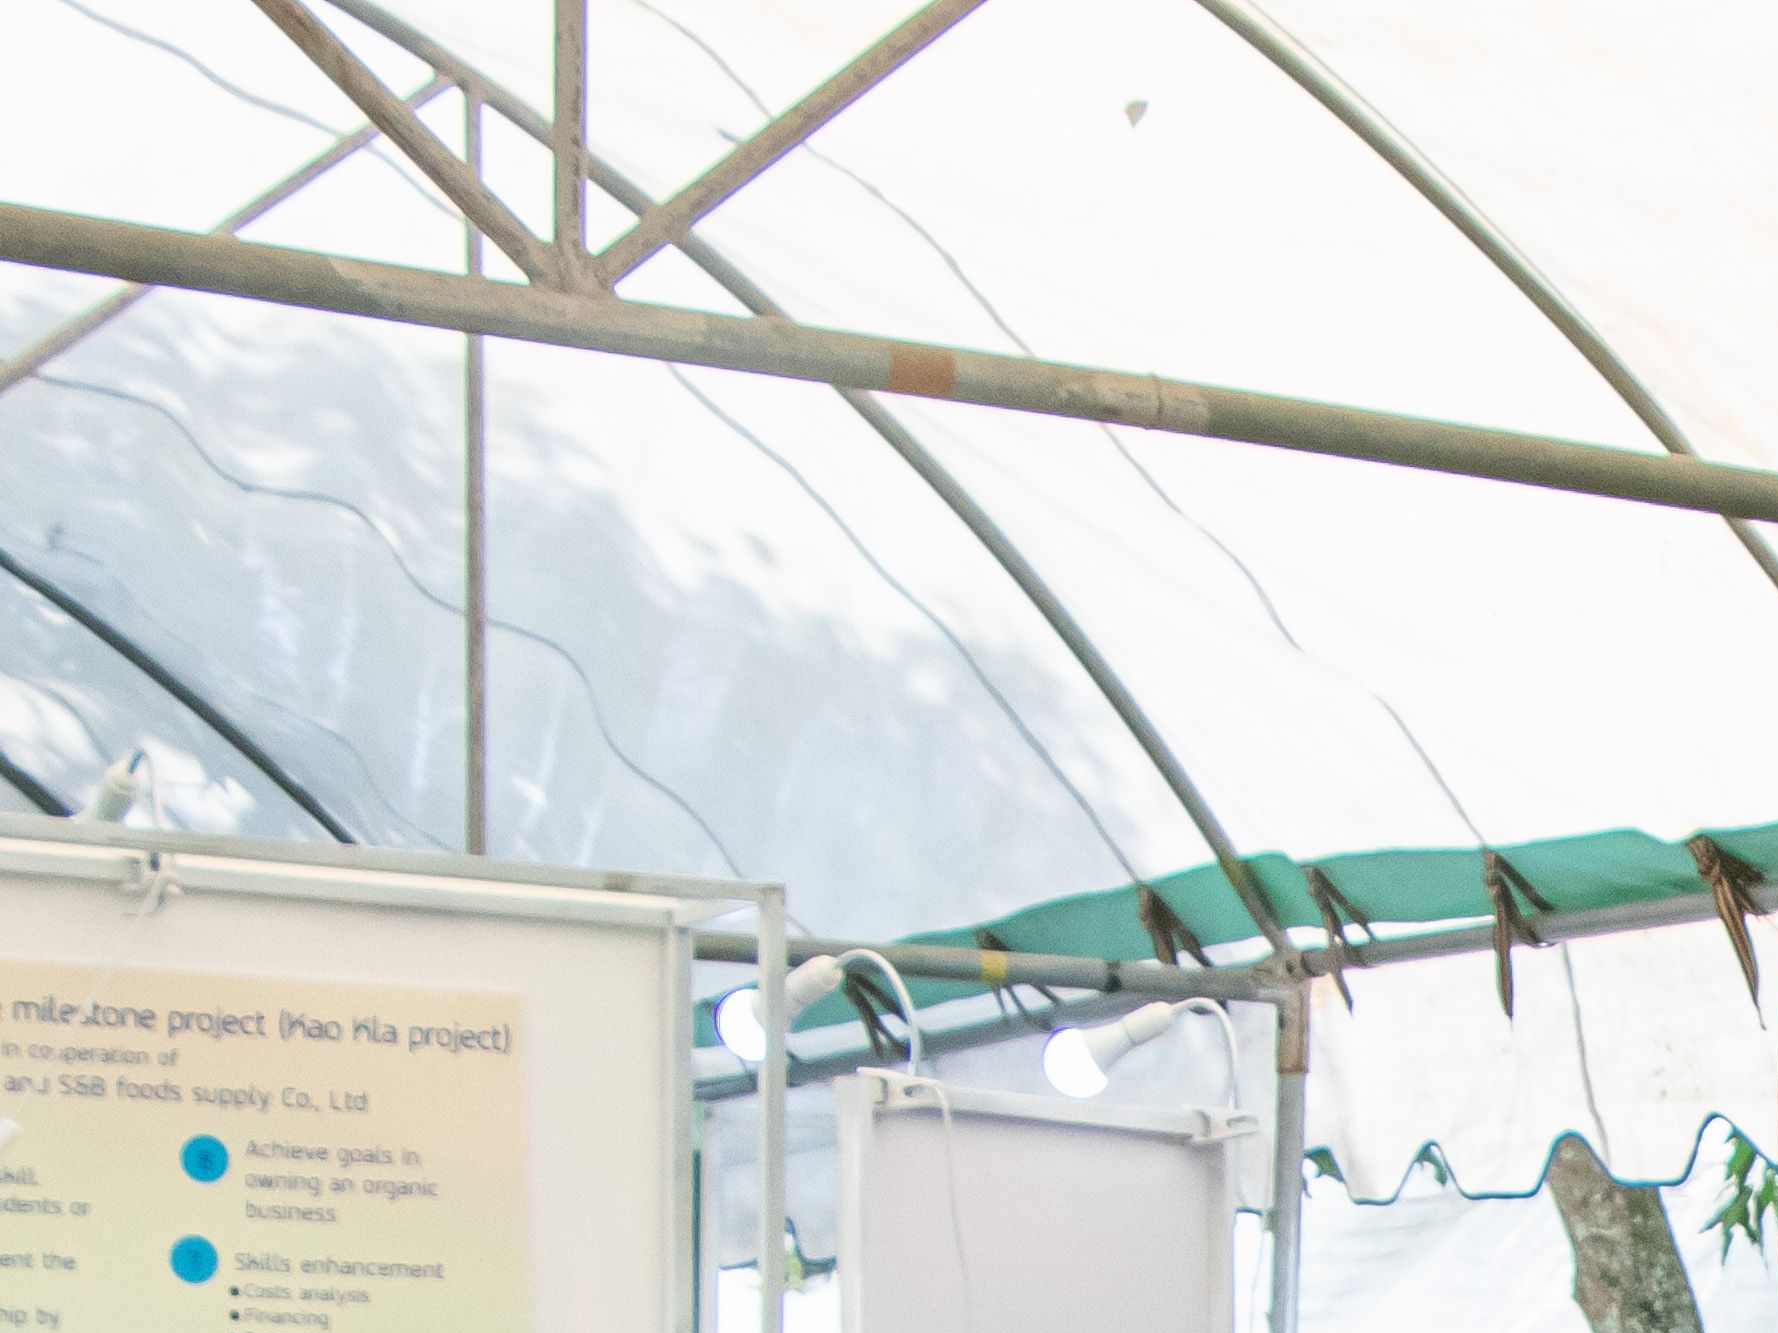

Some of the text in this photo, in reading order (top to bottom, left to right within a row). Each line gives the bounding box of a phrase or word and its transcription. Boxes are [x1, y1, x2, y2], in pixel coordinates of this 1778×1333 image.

[11, 996, 156, 1029] miletone
[168, 1006, 266, 1039] project
[408, 1022, 512, 1054] project)
[27, 1043, 149, 1066] coperation
[116, 1075, 183, 1101] foods
[192, 1086, 271, 1112] supply
[245, 1140, 421, 1168] Achieve goals in
[244, 1172, 439, 1200] owning an organic
[245, 1200, 336, 1222] business
[42, 1252, 77, 1271] the
[234, 1252, 444, 1278] Skills enhancement
[298, 1286, 370, 1304] analysis
[36, 1307, 60, 1330] by
[243, 1307, 330, 1330] Financing
